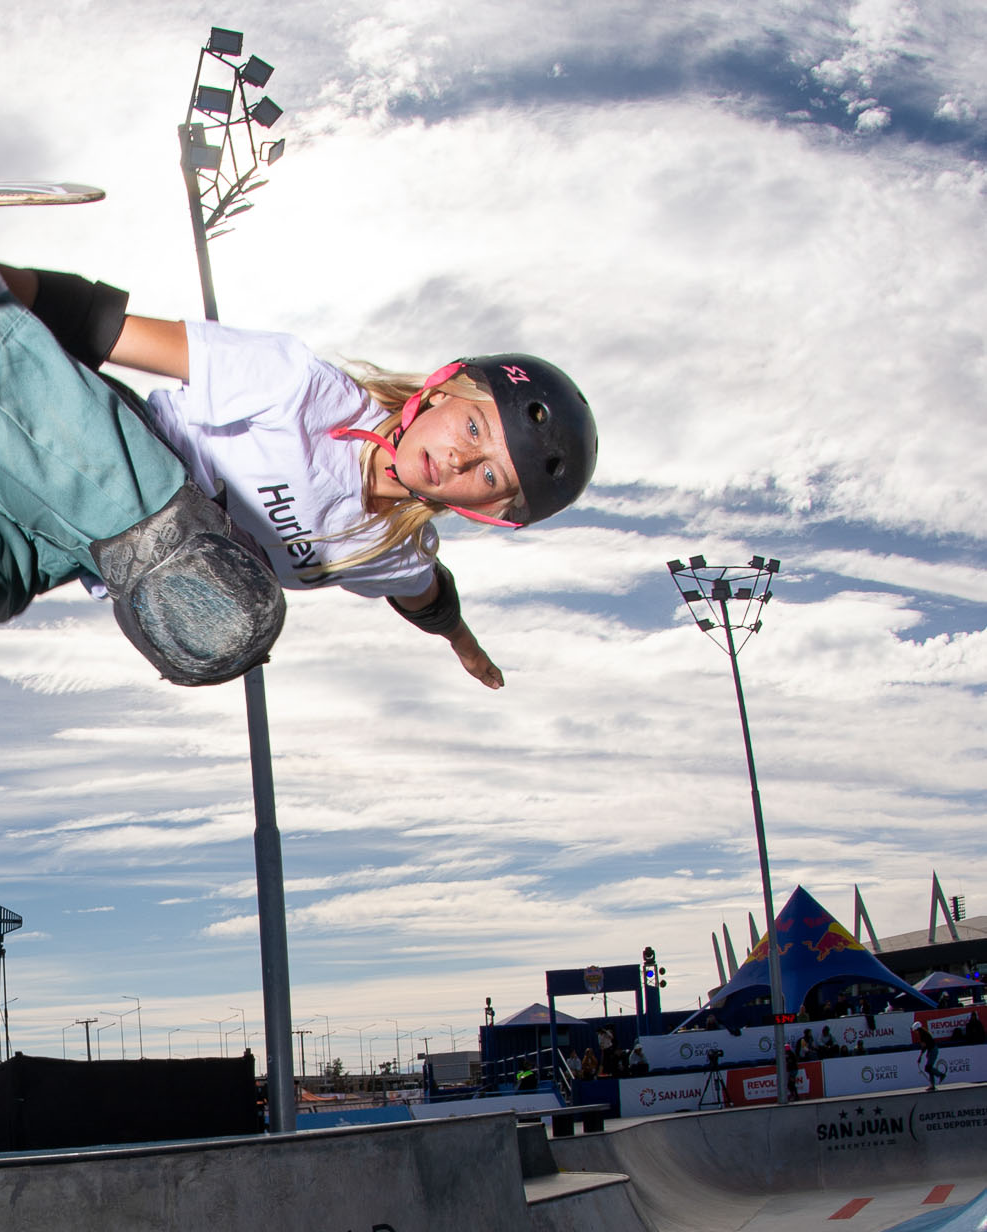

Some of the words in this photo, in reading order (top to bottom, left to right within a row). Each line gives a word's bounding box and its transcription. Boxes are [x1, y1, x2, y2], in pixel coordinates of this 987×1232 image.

[257, 484, 321, 569] Hurley
[858, 1030, 874, 1038] SAN
[875, 1027, 894, 1037] JUAN
[949, 1058, 970, 1066] WORLD
[875, 1065, 898, 1073] WORLD
[949, 1065, 970, 1073] SKATE
[875, 1072, 898, 1080] SKATE
[658, 1091, 676, 1101] SAN
[678, 1088, 701, 1099] JUAN
[919, 1111, 956, 1121] CAPITAL
[817, 1122, 852, 1141] SAN
[856, 1117, 903, 1136] JUAN
[926, 1123, 942, 1131] DEL
[943, 1119, 982, 1128] DEPORTE
